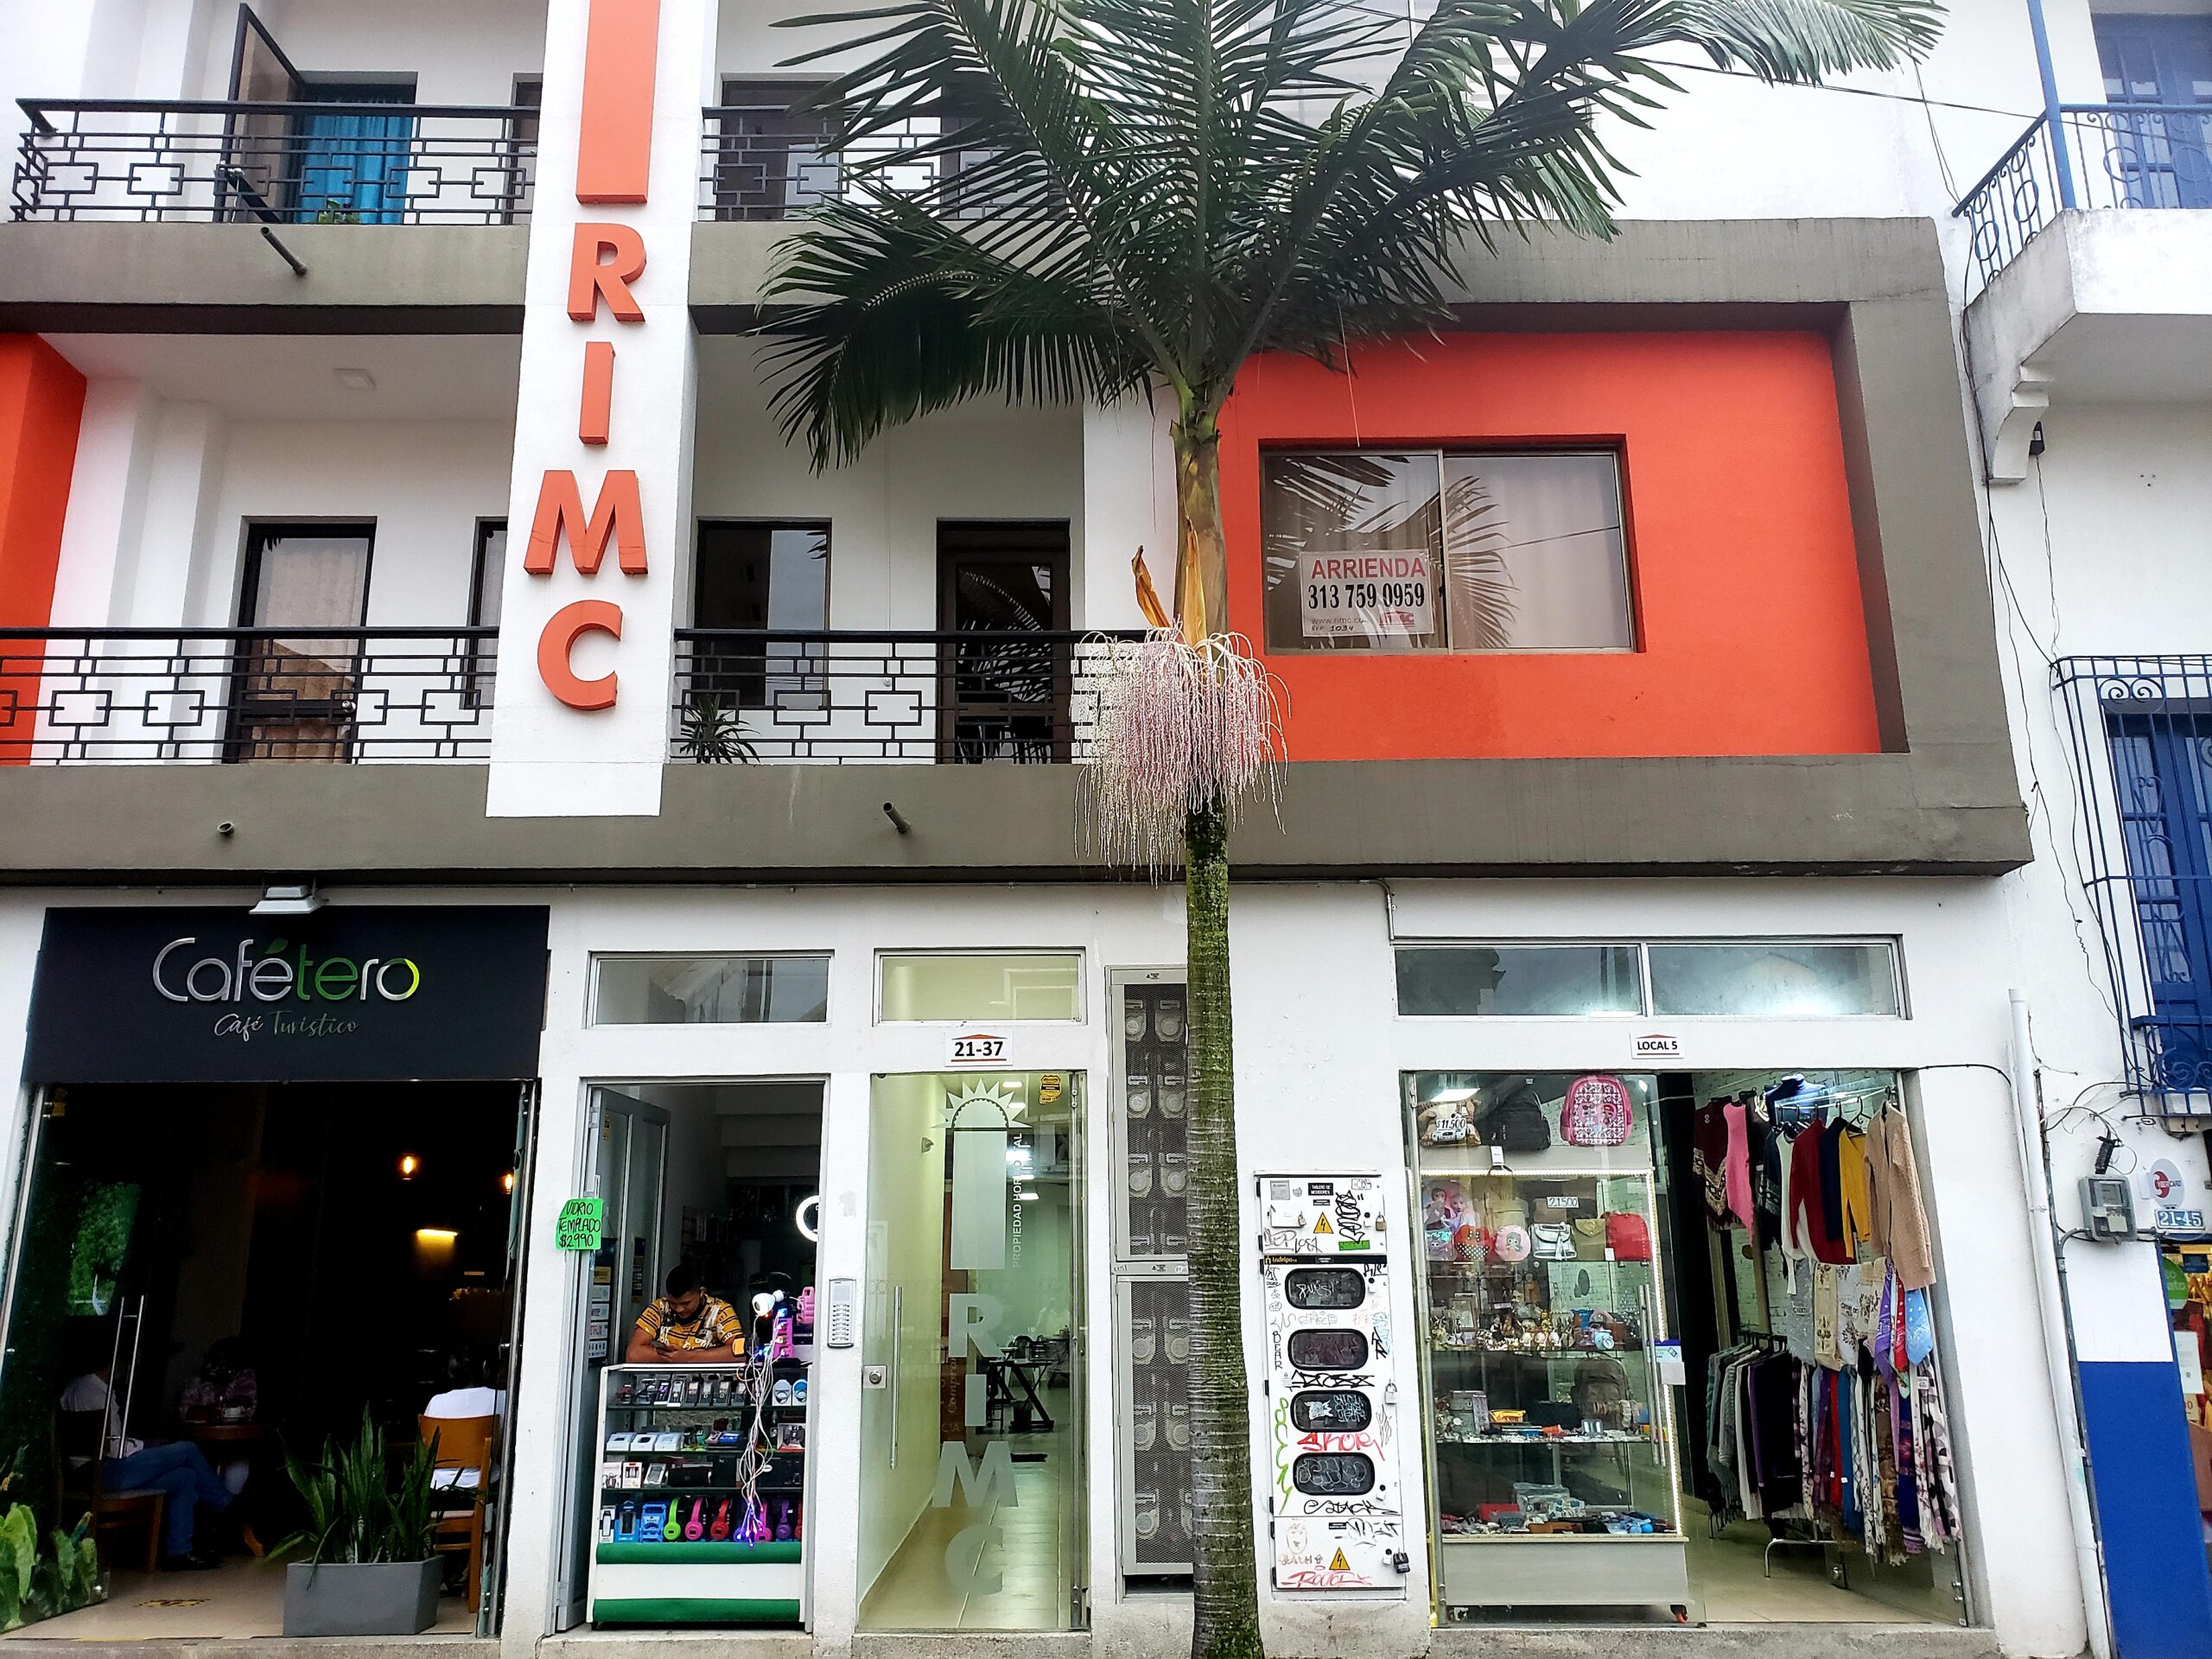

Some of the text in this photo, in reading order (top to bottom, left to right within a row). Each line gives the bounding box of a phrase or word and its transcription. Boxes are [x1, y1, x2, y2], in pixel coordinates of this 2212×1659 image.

[1311, 557, 1427, 580] ARRIENDA
[1308, 582, 1425, 609] 313 759 0959
[152, 937, 420, 1002] Cafétero
[213, 1013, 264, 1042] Café
[954, 1040, 1004, 1057] 21-37
[1637, 1040, 1678, 1051] LOCAL 5
[558, 1217, 601, 1234] TEMPLADO
[2160, 1211, 2202, 1226] 21-45
[558, 1233, 594, 1249] $2990
[1013, 1205, 1022, 1268] PROPIEDAD
